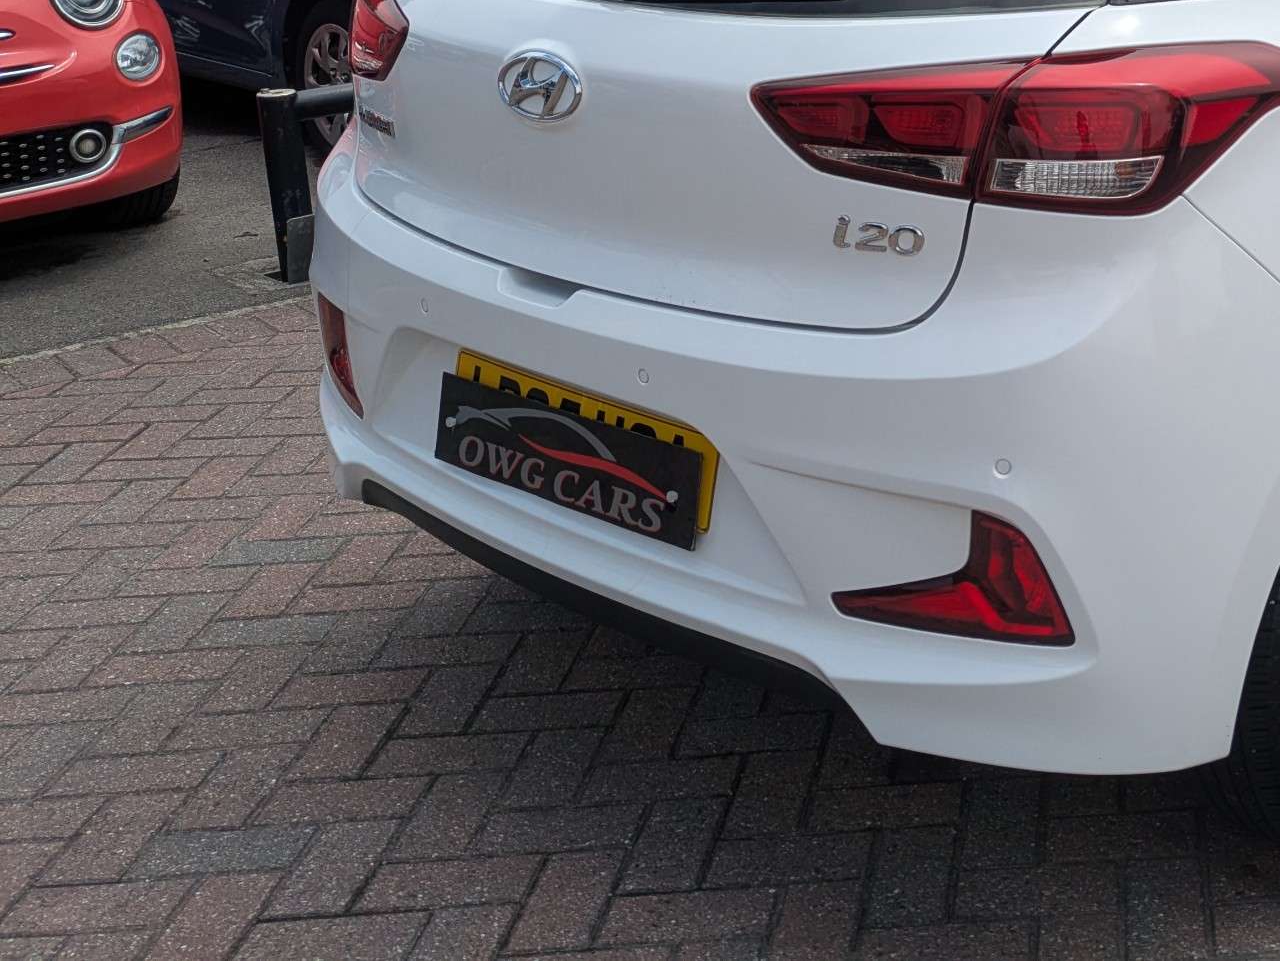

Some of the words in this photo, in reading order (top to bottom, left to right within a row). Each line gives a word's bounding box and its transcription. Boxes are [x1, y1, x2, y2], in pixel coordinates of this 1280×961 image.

[832, 214, 926, 256] i20
[457, 435, 546, 490] OWG
[552, 469, 665, 533] CARS
